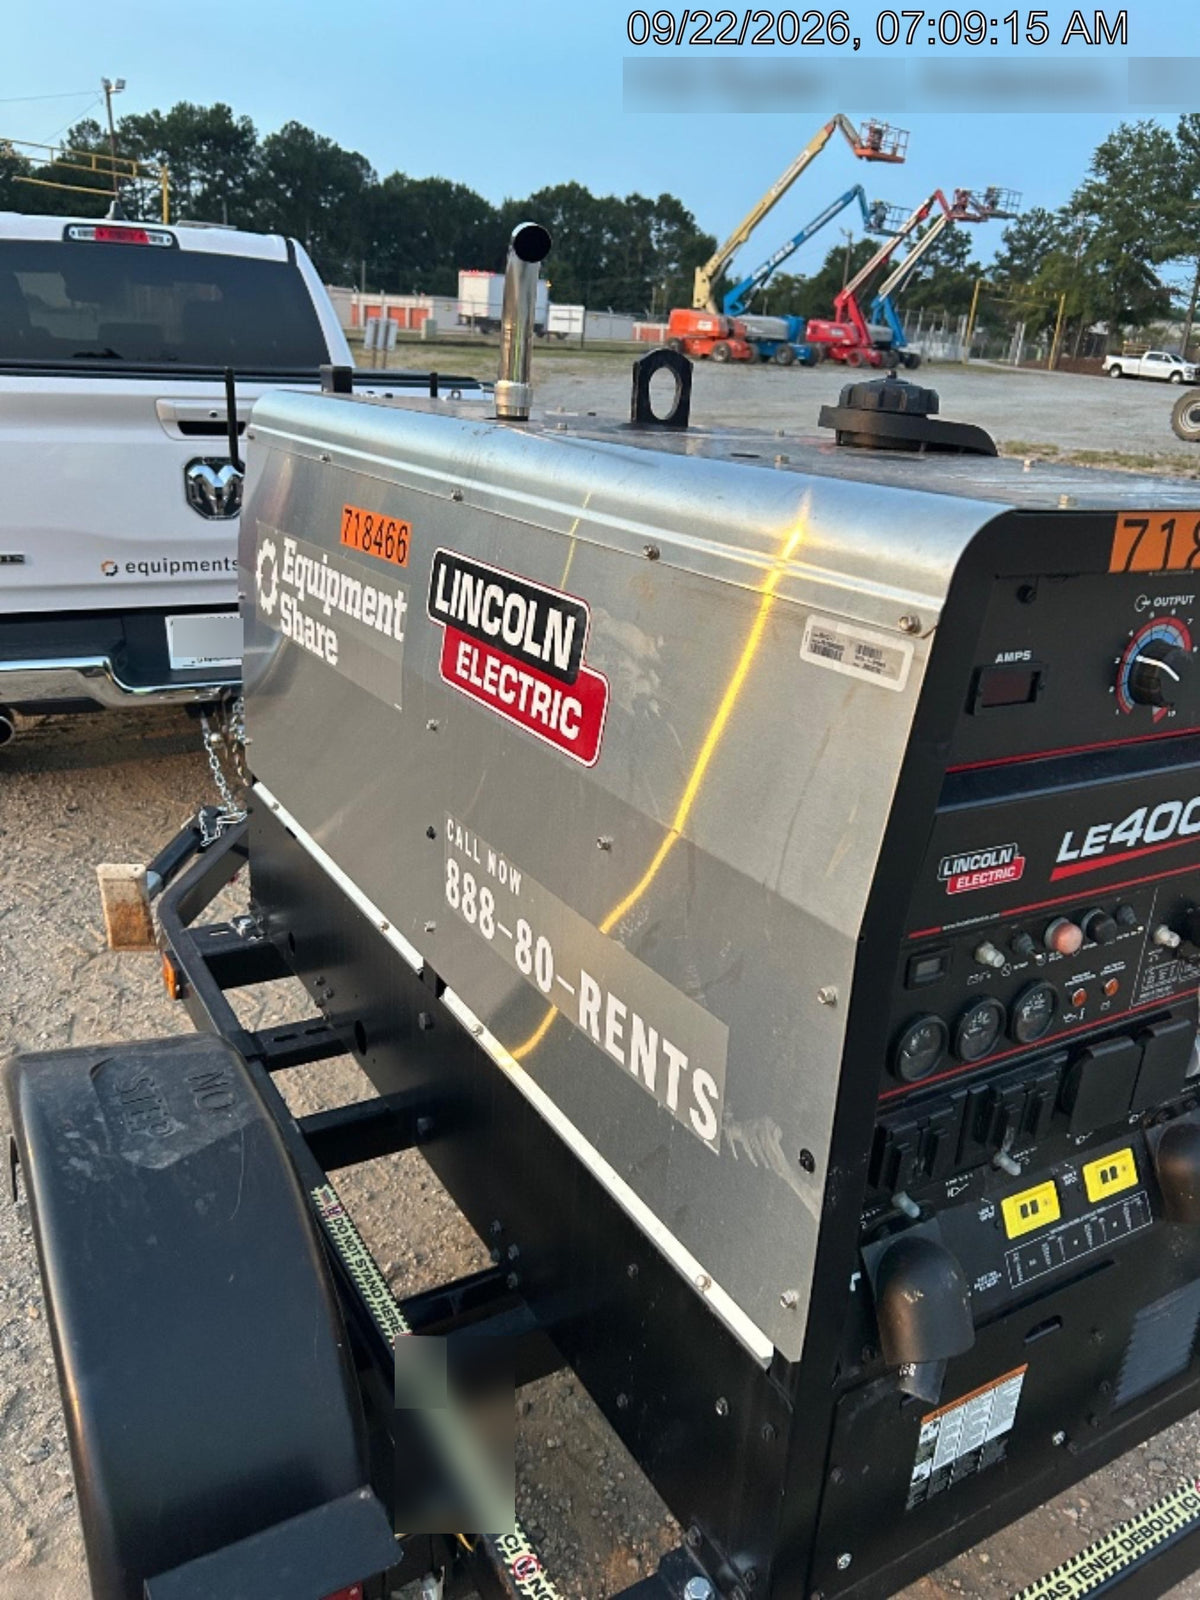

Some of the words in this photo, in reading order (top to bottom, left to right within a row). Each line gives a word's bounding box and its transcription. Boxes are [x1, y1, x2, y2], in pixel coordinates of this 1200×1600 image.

[344, 508, 408, 564] 718466
[281, 536, 408, 642] Equipment
[435, 563, 576, 671] LINCOLN
[1153, 594, 1195, 608] OUTPUT
[280, 591, 339, 666] Share
[994, 649, 1032, 665] AMPS
[455, 639, 583, 741] ELECTRIC
[446, 818, 481, 865] CALL
[487, 848, 522, 896] NOW
[943, 847, 1013, 876] LINCOLN
[956, 866, 1016, 889] ELECTRIC
[445, 857, 720, 1141] 888-80-RENTS
[113, 1072, 176, 1138] STEP
[185, 1070, 236, 1112] NO
[333, 1217, 349, 1235] DO
[345, 1237, 362, 1258] NOT
[355, 1258, 383, 1299] STAND
[378, 1300, 404, 1335] HERE
[504, 1533, 523, 1555] CI
[1068, 1546, 1123, 1586] TENEZ
[1119, 1505, 1182, 1552] DEBOUT
